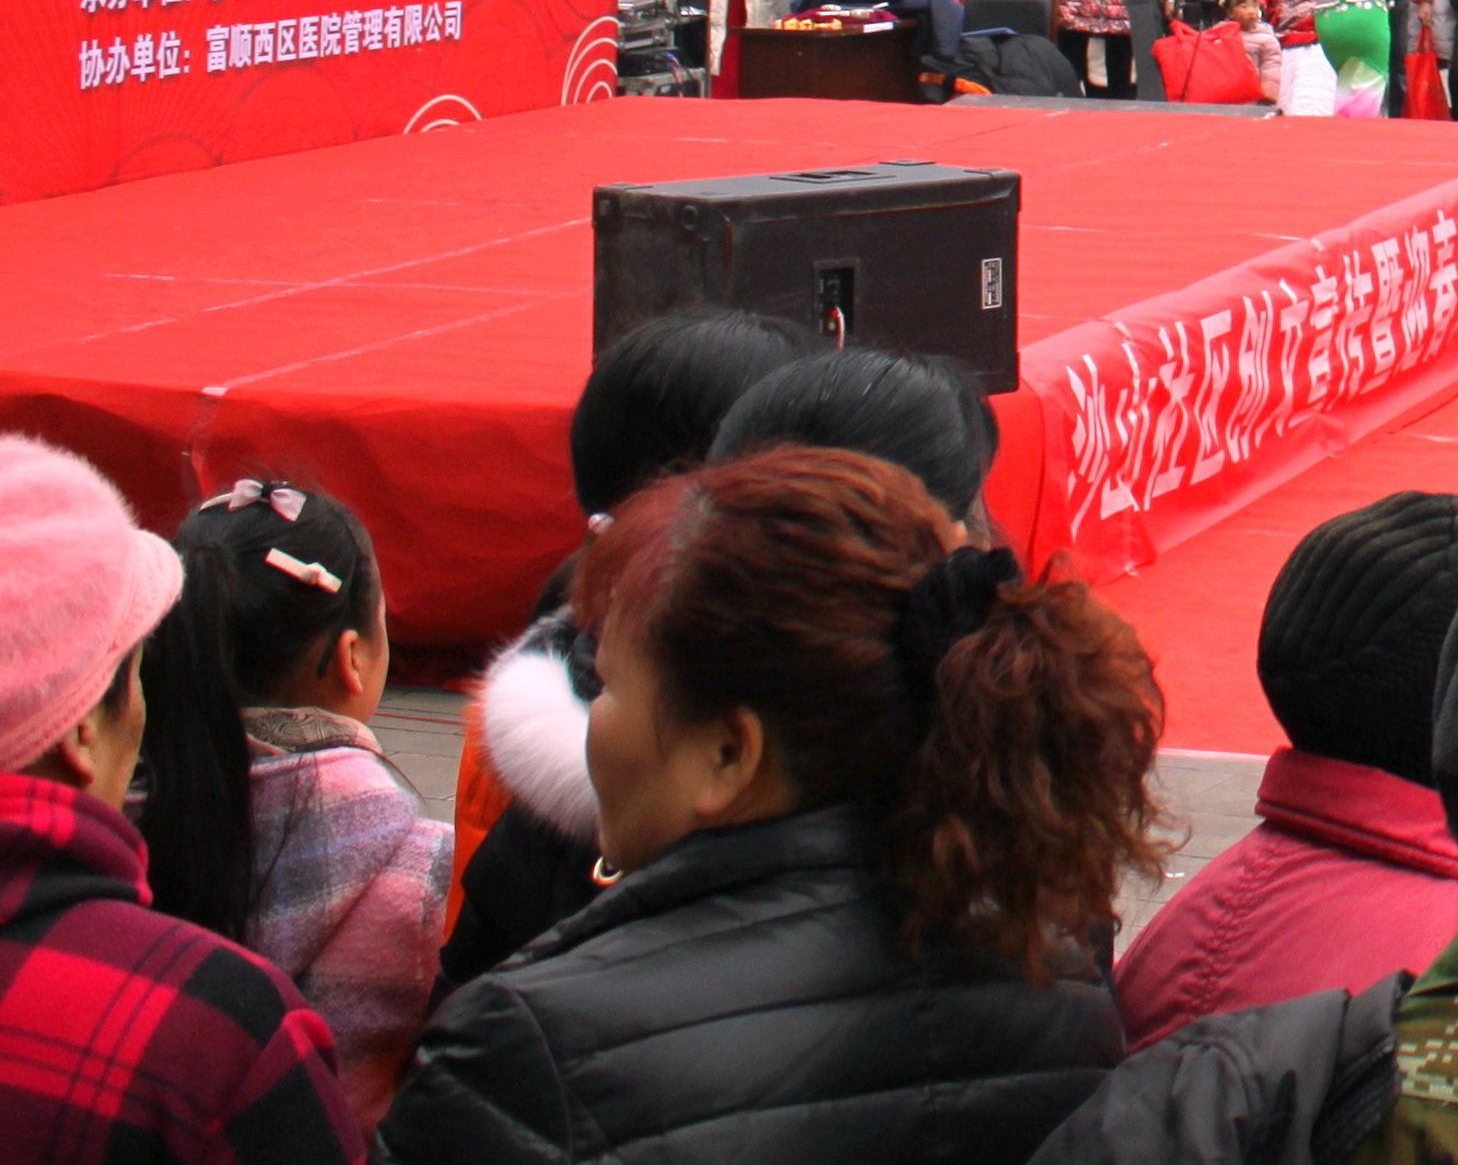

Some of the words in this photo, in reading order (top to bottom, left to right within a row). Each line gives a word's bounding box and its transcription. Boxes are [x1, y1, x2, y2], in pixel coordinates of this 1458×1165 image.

[207, 1, 461, 72] 富顺西区医院管理有限公司
